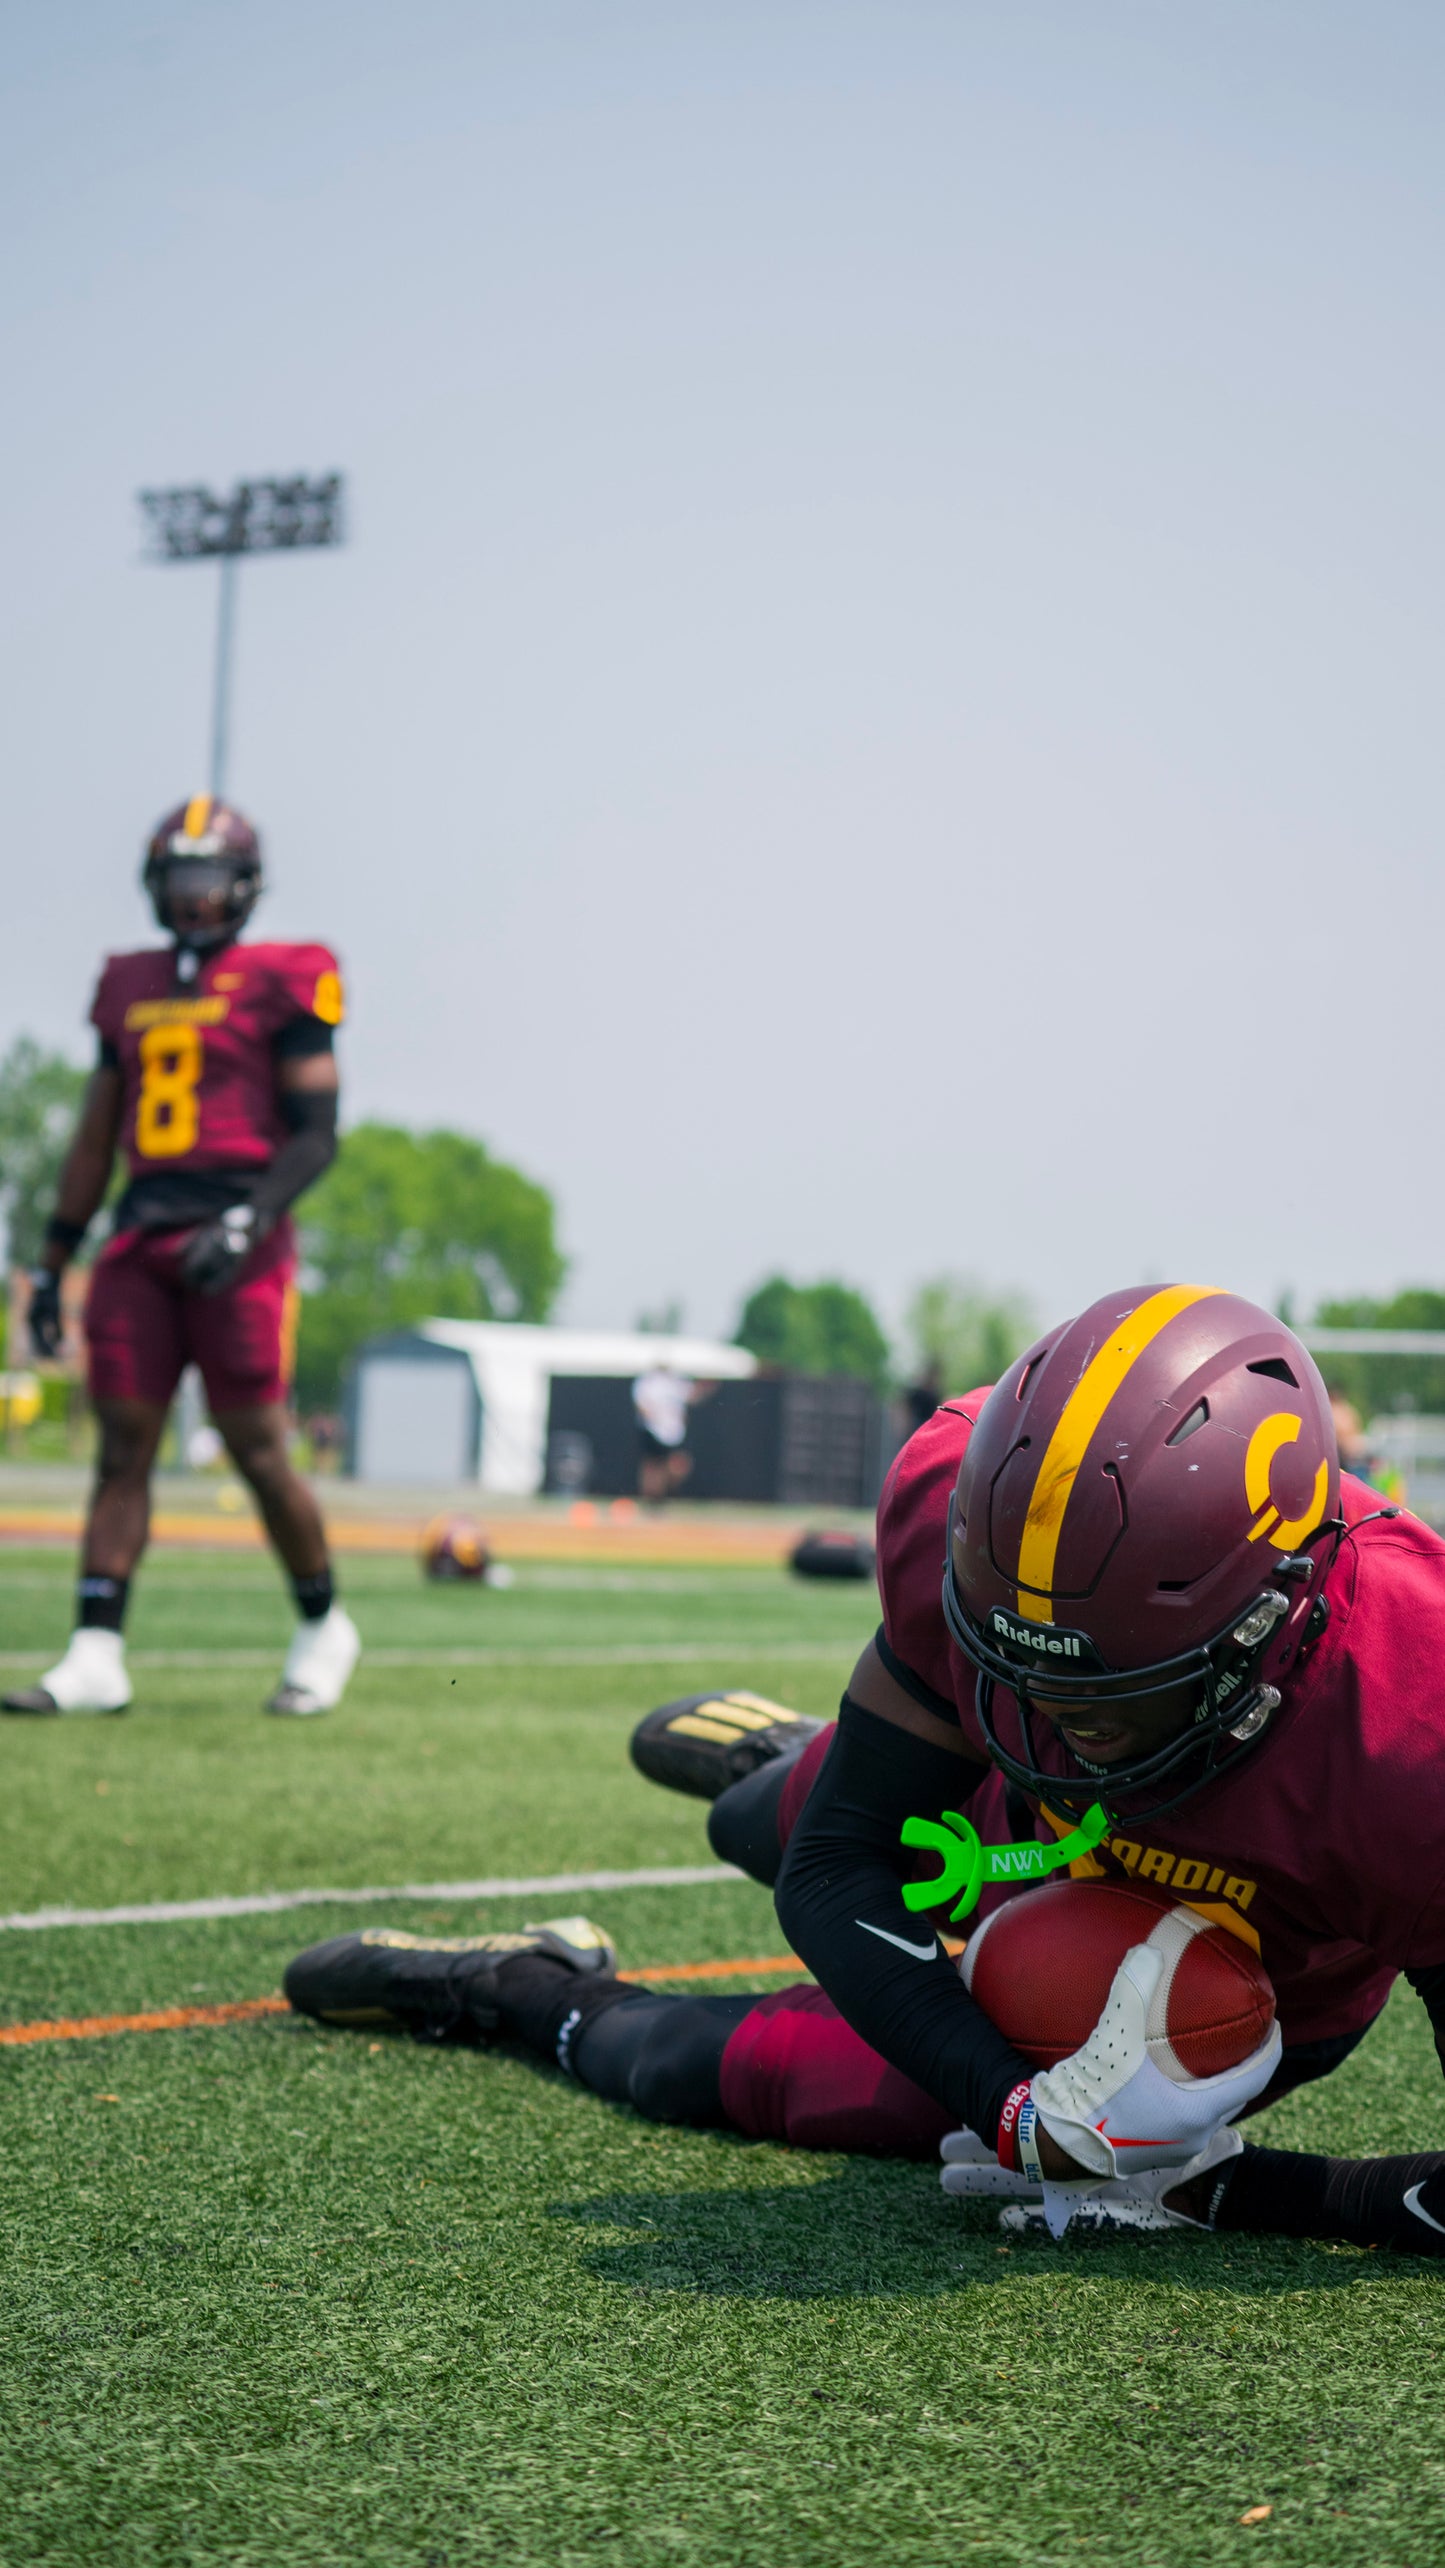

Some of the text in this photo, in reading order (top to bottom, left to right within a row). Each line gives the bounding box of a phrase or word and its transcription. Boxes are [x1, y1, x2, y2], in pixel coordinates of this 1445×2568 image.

[136, 1024, 202, 1158] 8
[993, 1613, 1080, 1657] Riddell
[1195, 1671, 1241, 1723] Riell
[992, 1849, 1043, 1873] NWY
[1101, 1835, 1257, 1910] ORDIA
[1001, 2085, 1029, 2133] CHOP
